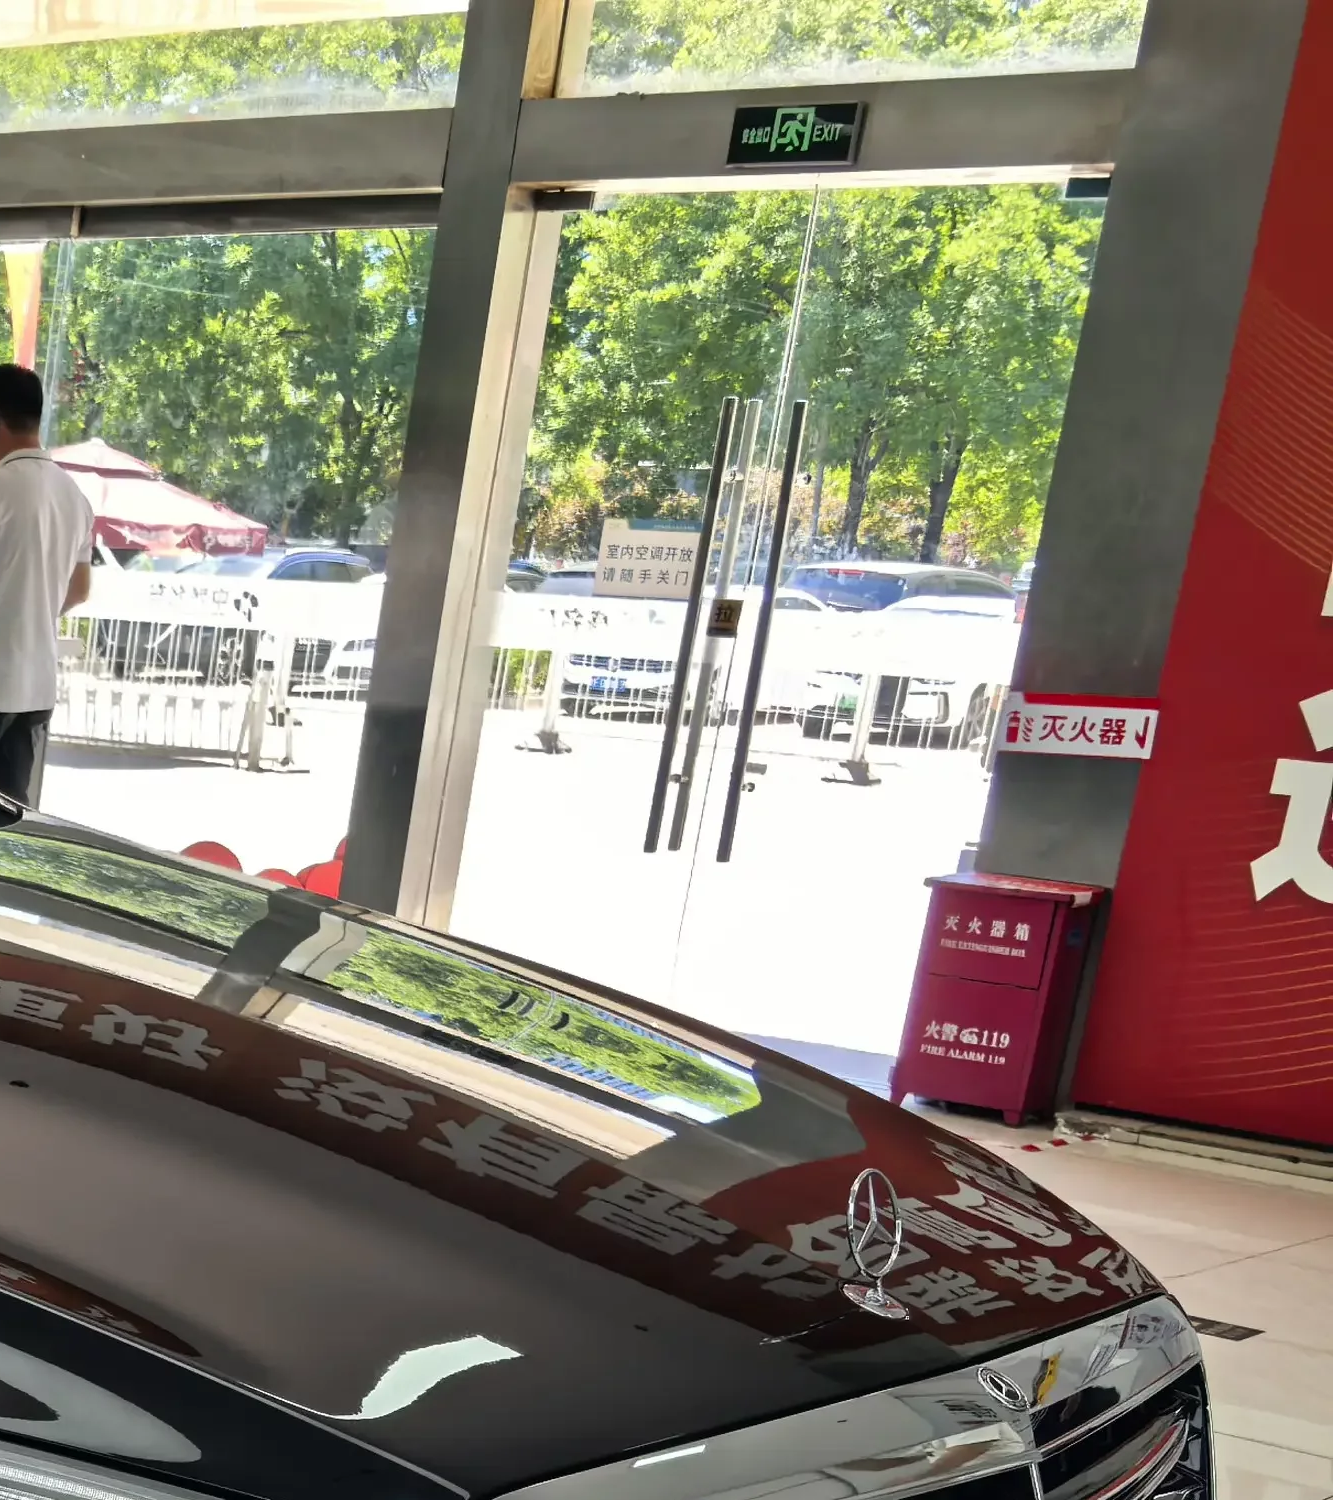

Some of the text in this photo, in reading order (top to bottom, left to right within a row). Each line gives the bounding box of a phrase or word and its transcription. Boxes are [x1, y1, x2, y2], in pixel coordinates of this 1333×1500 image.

[813, 123, 842, 142] EXIT
[606, 544, 694, 563] 室内空调开放
[602, 567, 689, 586] 请随手关门
[715, 604, 733, 623] 拉
[1039, 715, 1126, 745] 灭火器
[943, 915, 1031, 942] 灭火器箱
[924, 1021, 1010, 1048] 火警 119
[920, 1044, 1006, 1065] FIRE ALARM 119
